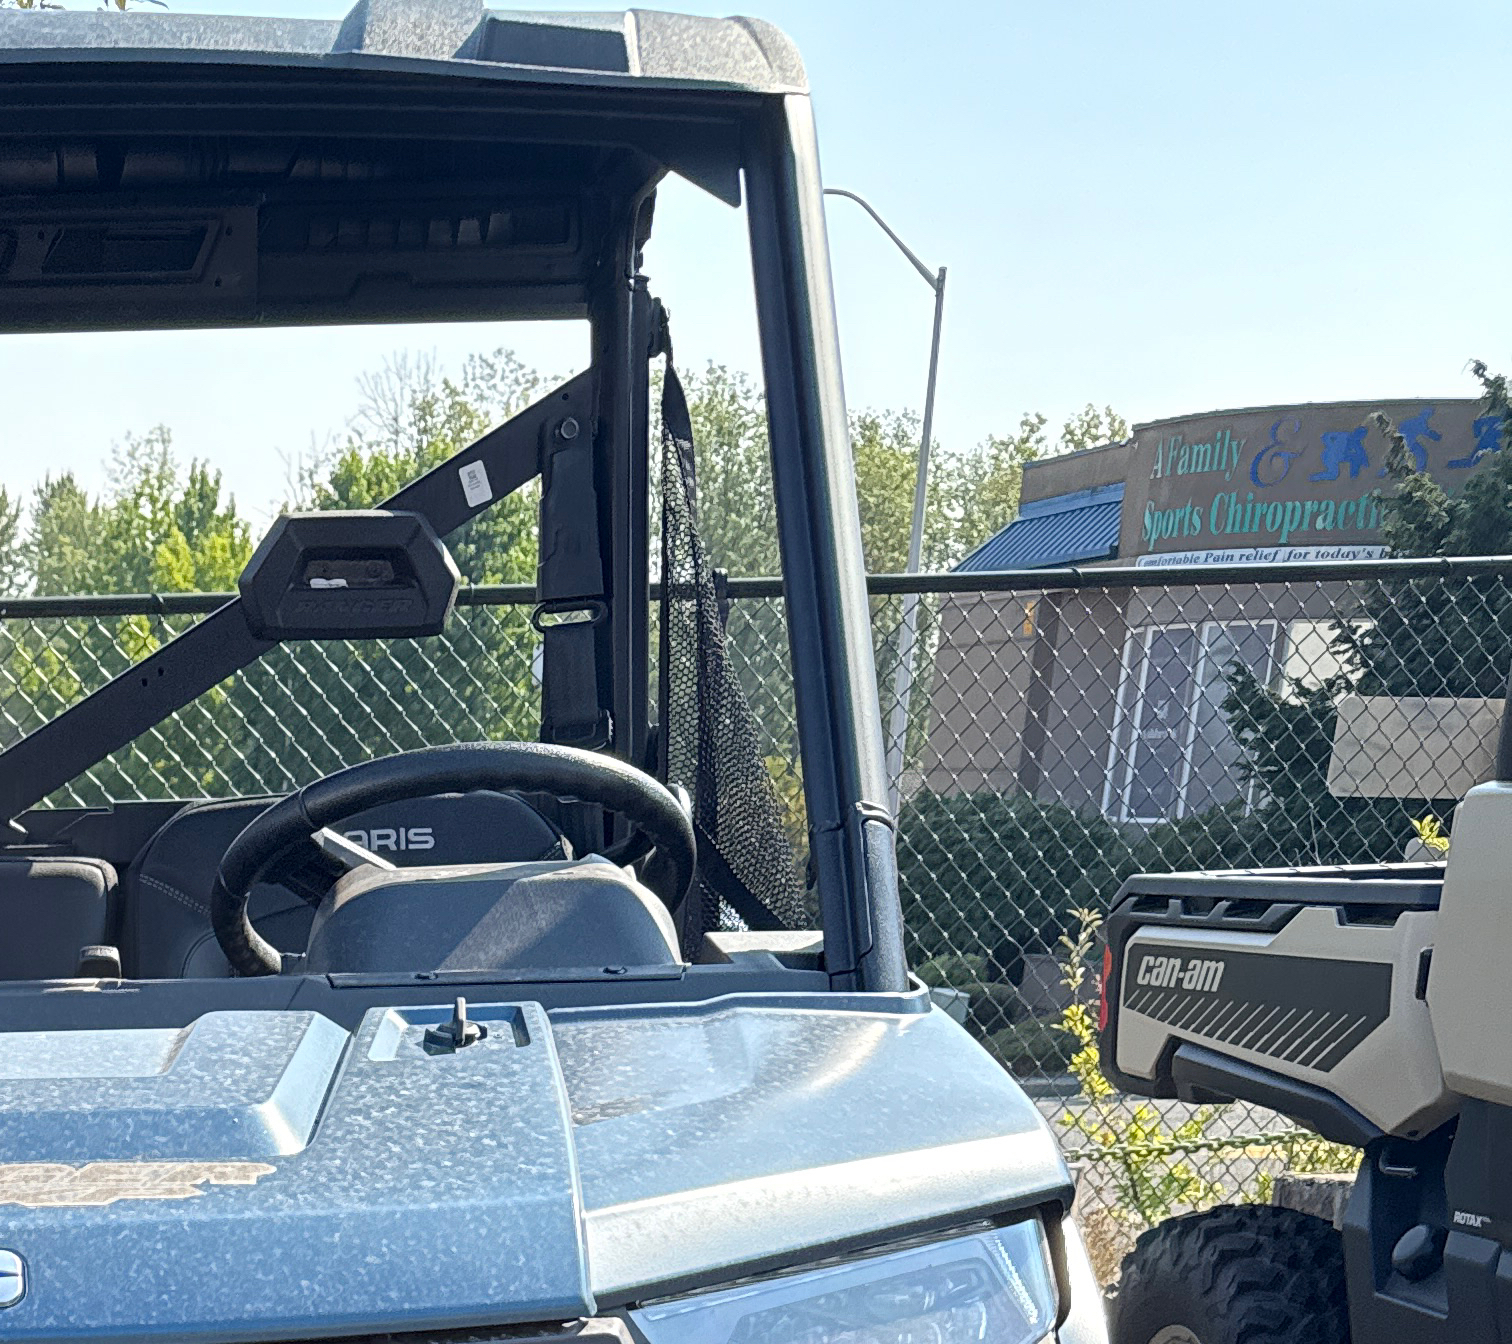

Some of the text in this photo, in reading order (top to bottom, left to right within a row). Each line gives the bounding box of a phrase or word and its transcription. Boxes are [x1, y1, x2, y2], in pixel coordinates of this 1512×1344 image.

[1149, 435, 1163, 479] A
[1165, 430, 1246, 481] Family
[1142, 497, 1203, 551] Sports
[1205, 551, 1235, 563] Pain
[1238, 548, 1281, 563] relief
[1285, 549, 1310, 562] for
[1314, 548, 1373, 561] today's
[343, 827, 435, 850] ARIS
[1137, 955, 1225, 993] can-am
